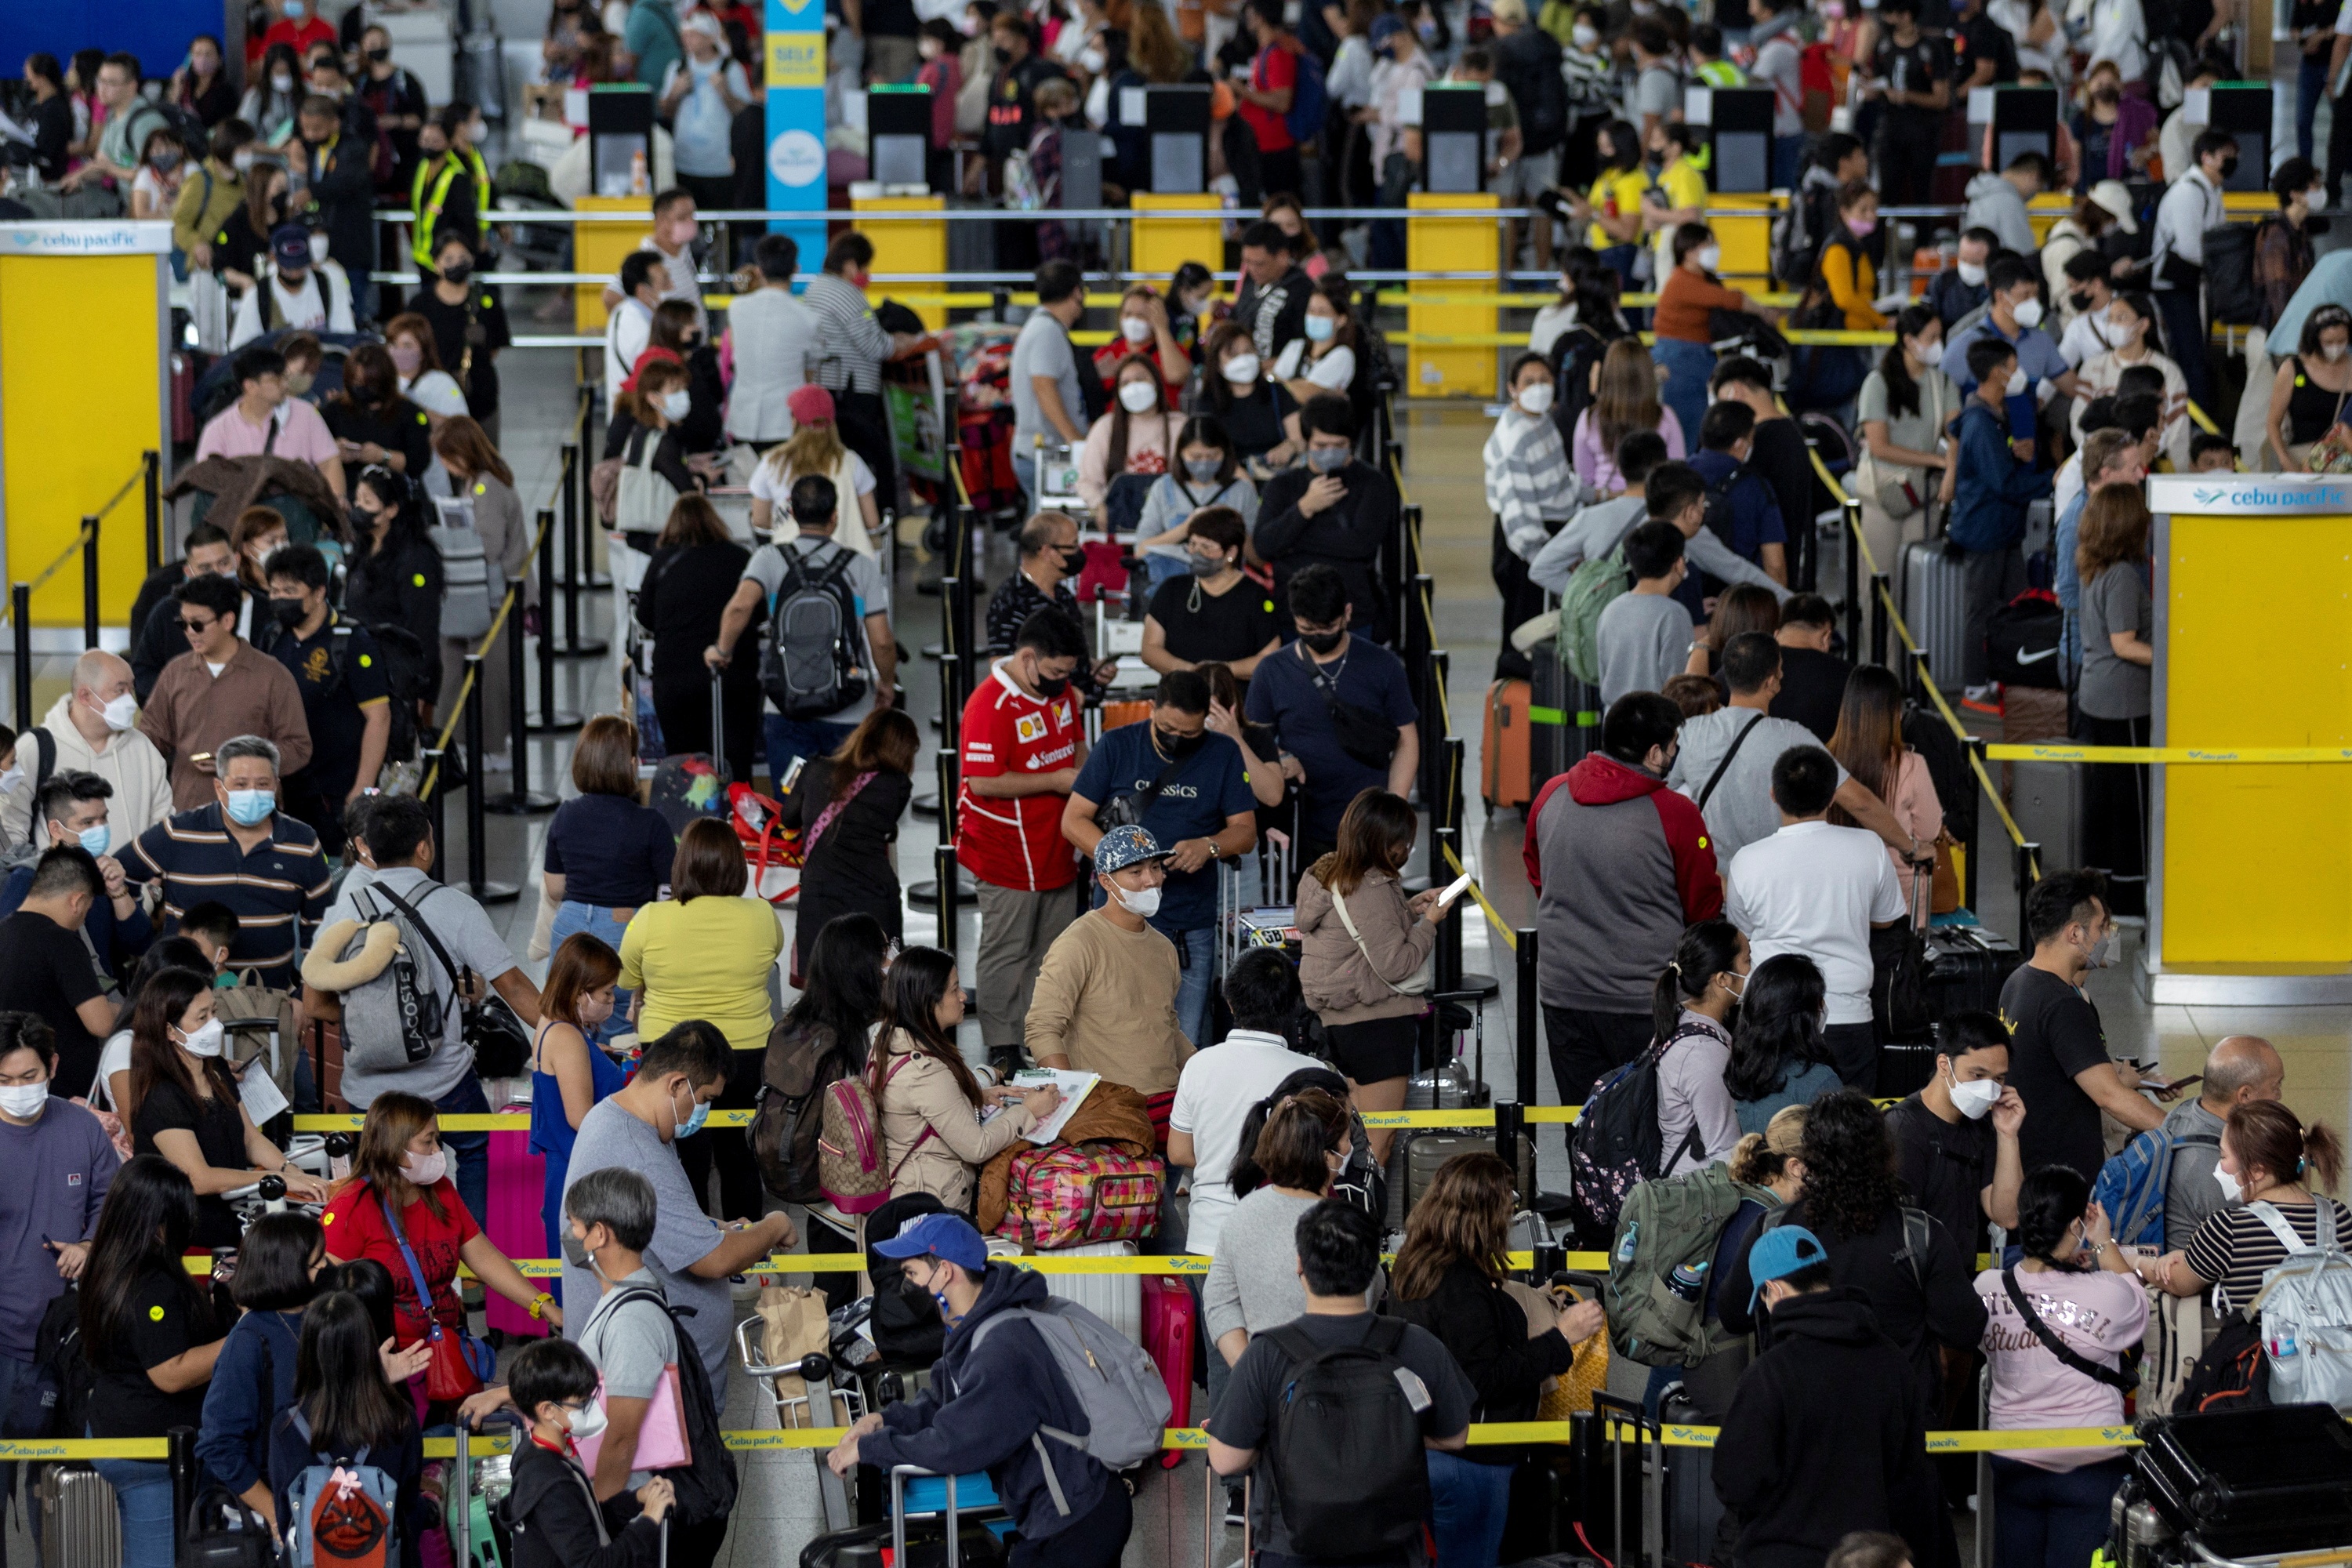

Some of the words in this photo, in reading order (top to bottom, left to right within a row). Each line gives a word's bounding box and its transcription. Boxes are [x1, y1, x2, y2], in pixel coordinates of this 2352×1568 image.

[42, 231, 81, 245] cebu
[84, 230, 136, 251] pacific
[2230, 486, 2278, 506] cebu
[2281, 485, 2347, 507] pacific
[400, 971, 426, 1051] LACOSTE
[1364, 1114, 1383, 1124] cebu
[1384, 1115, 1410, 1126] pacific
[750, 1261, 779, 1271] pacific
[730, 1436, 752, 1446] cebu
[753, 1436, 784, 1446] pacific
[1194, 1435, 1209, 1444] ceb
[1690, 1432, 1711, 1443] cebu
[1929, 1437, 1959, 1449] pacific
[13, 1446, 35, 1456] cebu
[36, 1444, 67, 1457] pacific
